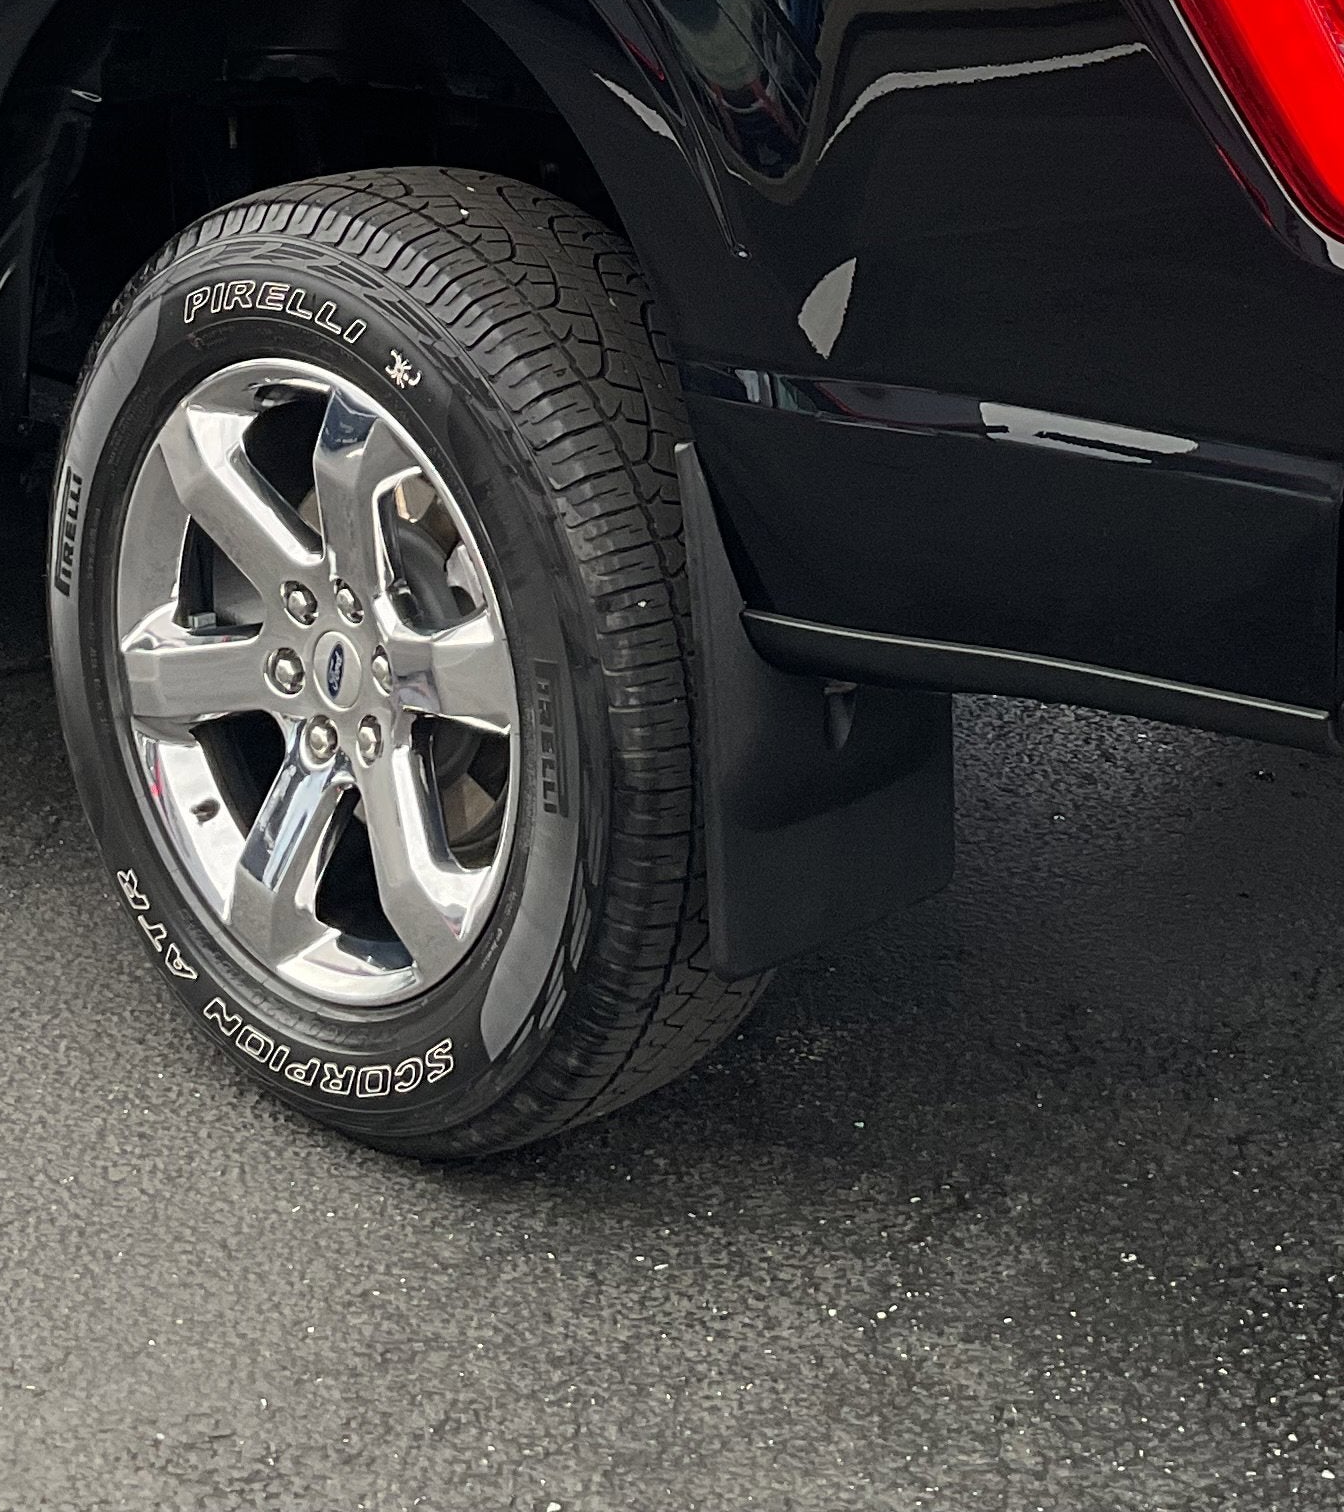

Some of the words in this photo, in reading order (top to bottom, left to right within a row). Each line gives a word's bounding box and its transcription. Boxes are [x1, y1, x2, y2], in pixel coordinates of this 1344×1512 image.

[184, 279, 367, 344] PIRELLI
[54, 466, 83, 597] PIRELLI
[117, 868, 198, 979] ATR
[203, 997, 454, 1097] SCORPION
